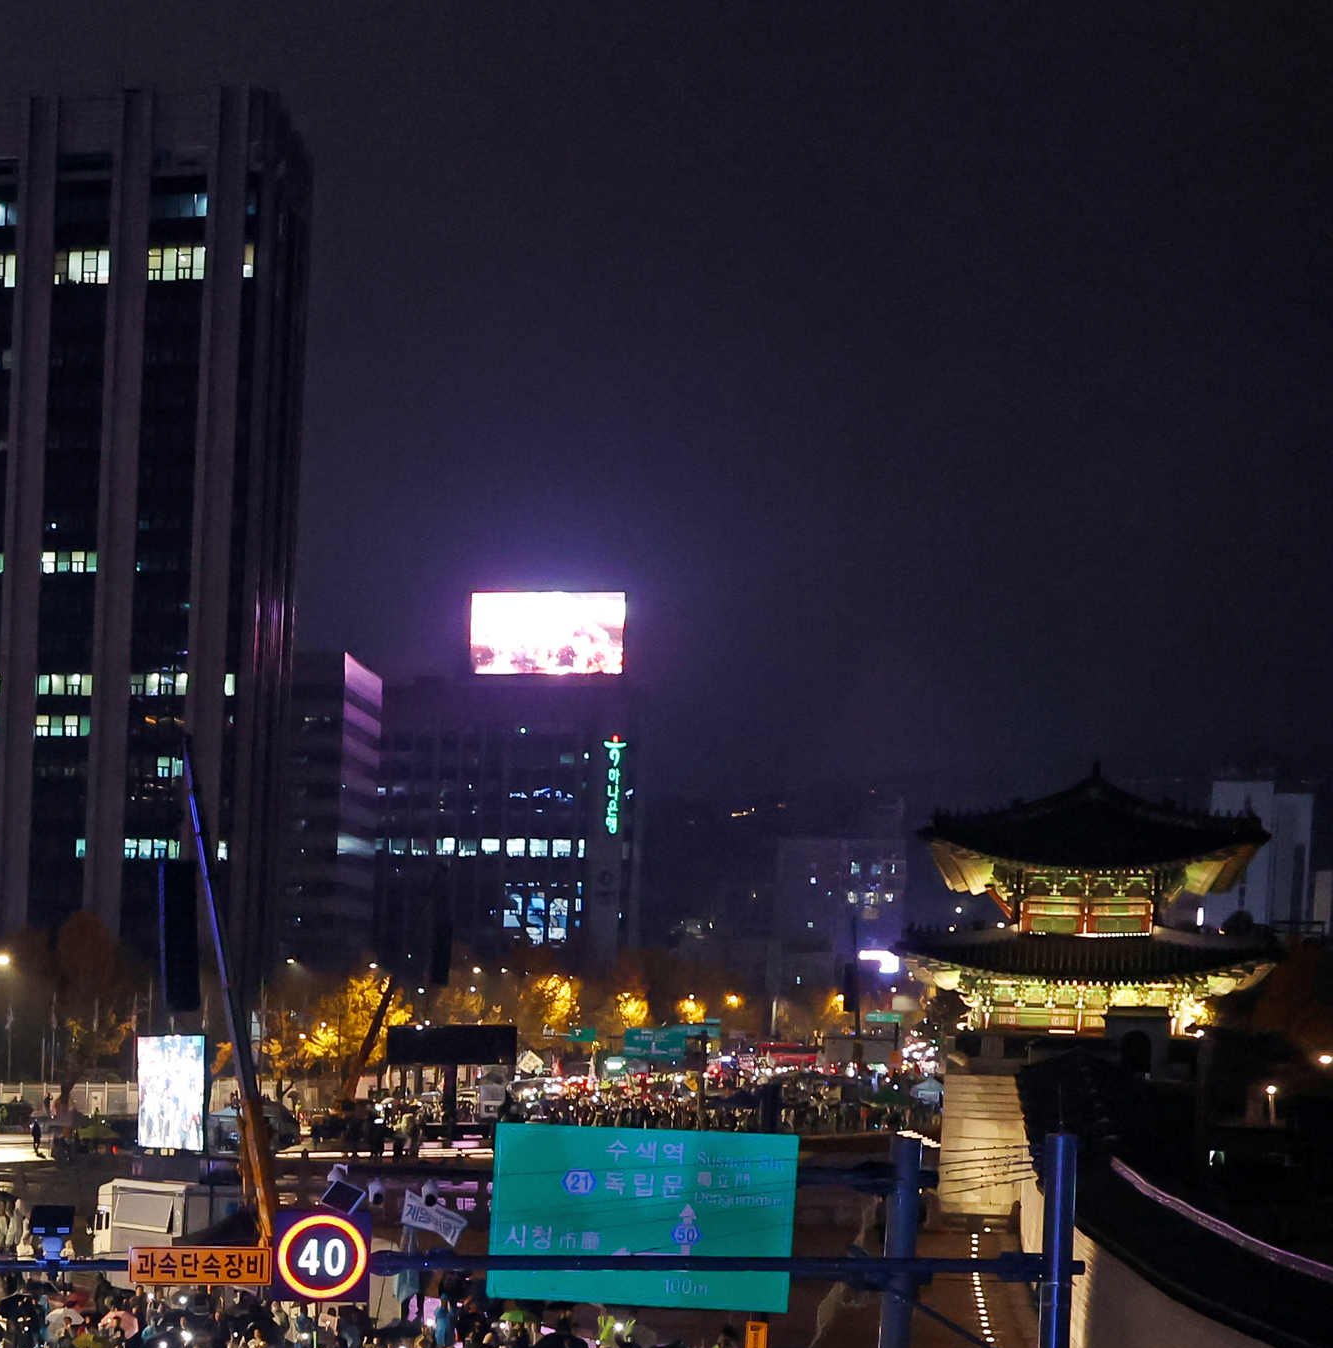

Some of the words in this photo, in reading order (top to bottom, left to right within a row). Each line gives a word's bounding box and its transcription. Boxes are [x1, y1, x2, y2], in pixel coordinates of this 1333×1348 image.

[605, 768, 621, 835] 하나은행
[606, 1139, 685, 1163] 수색역
[571, 1174, 590, 1191] 21
[605, 1172, 684, 1198] 독립문
[505, 1225, 553, 1249] 시청
[676, 1227, 696, 1242] 50
[136, 1251, 264, 1281] 과속단속장비
[298, 1238, 346, 1277] 40
[665, 1278, 709, 1296] 100m
